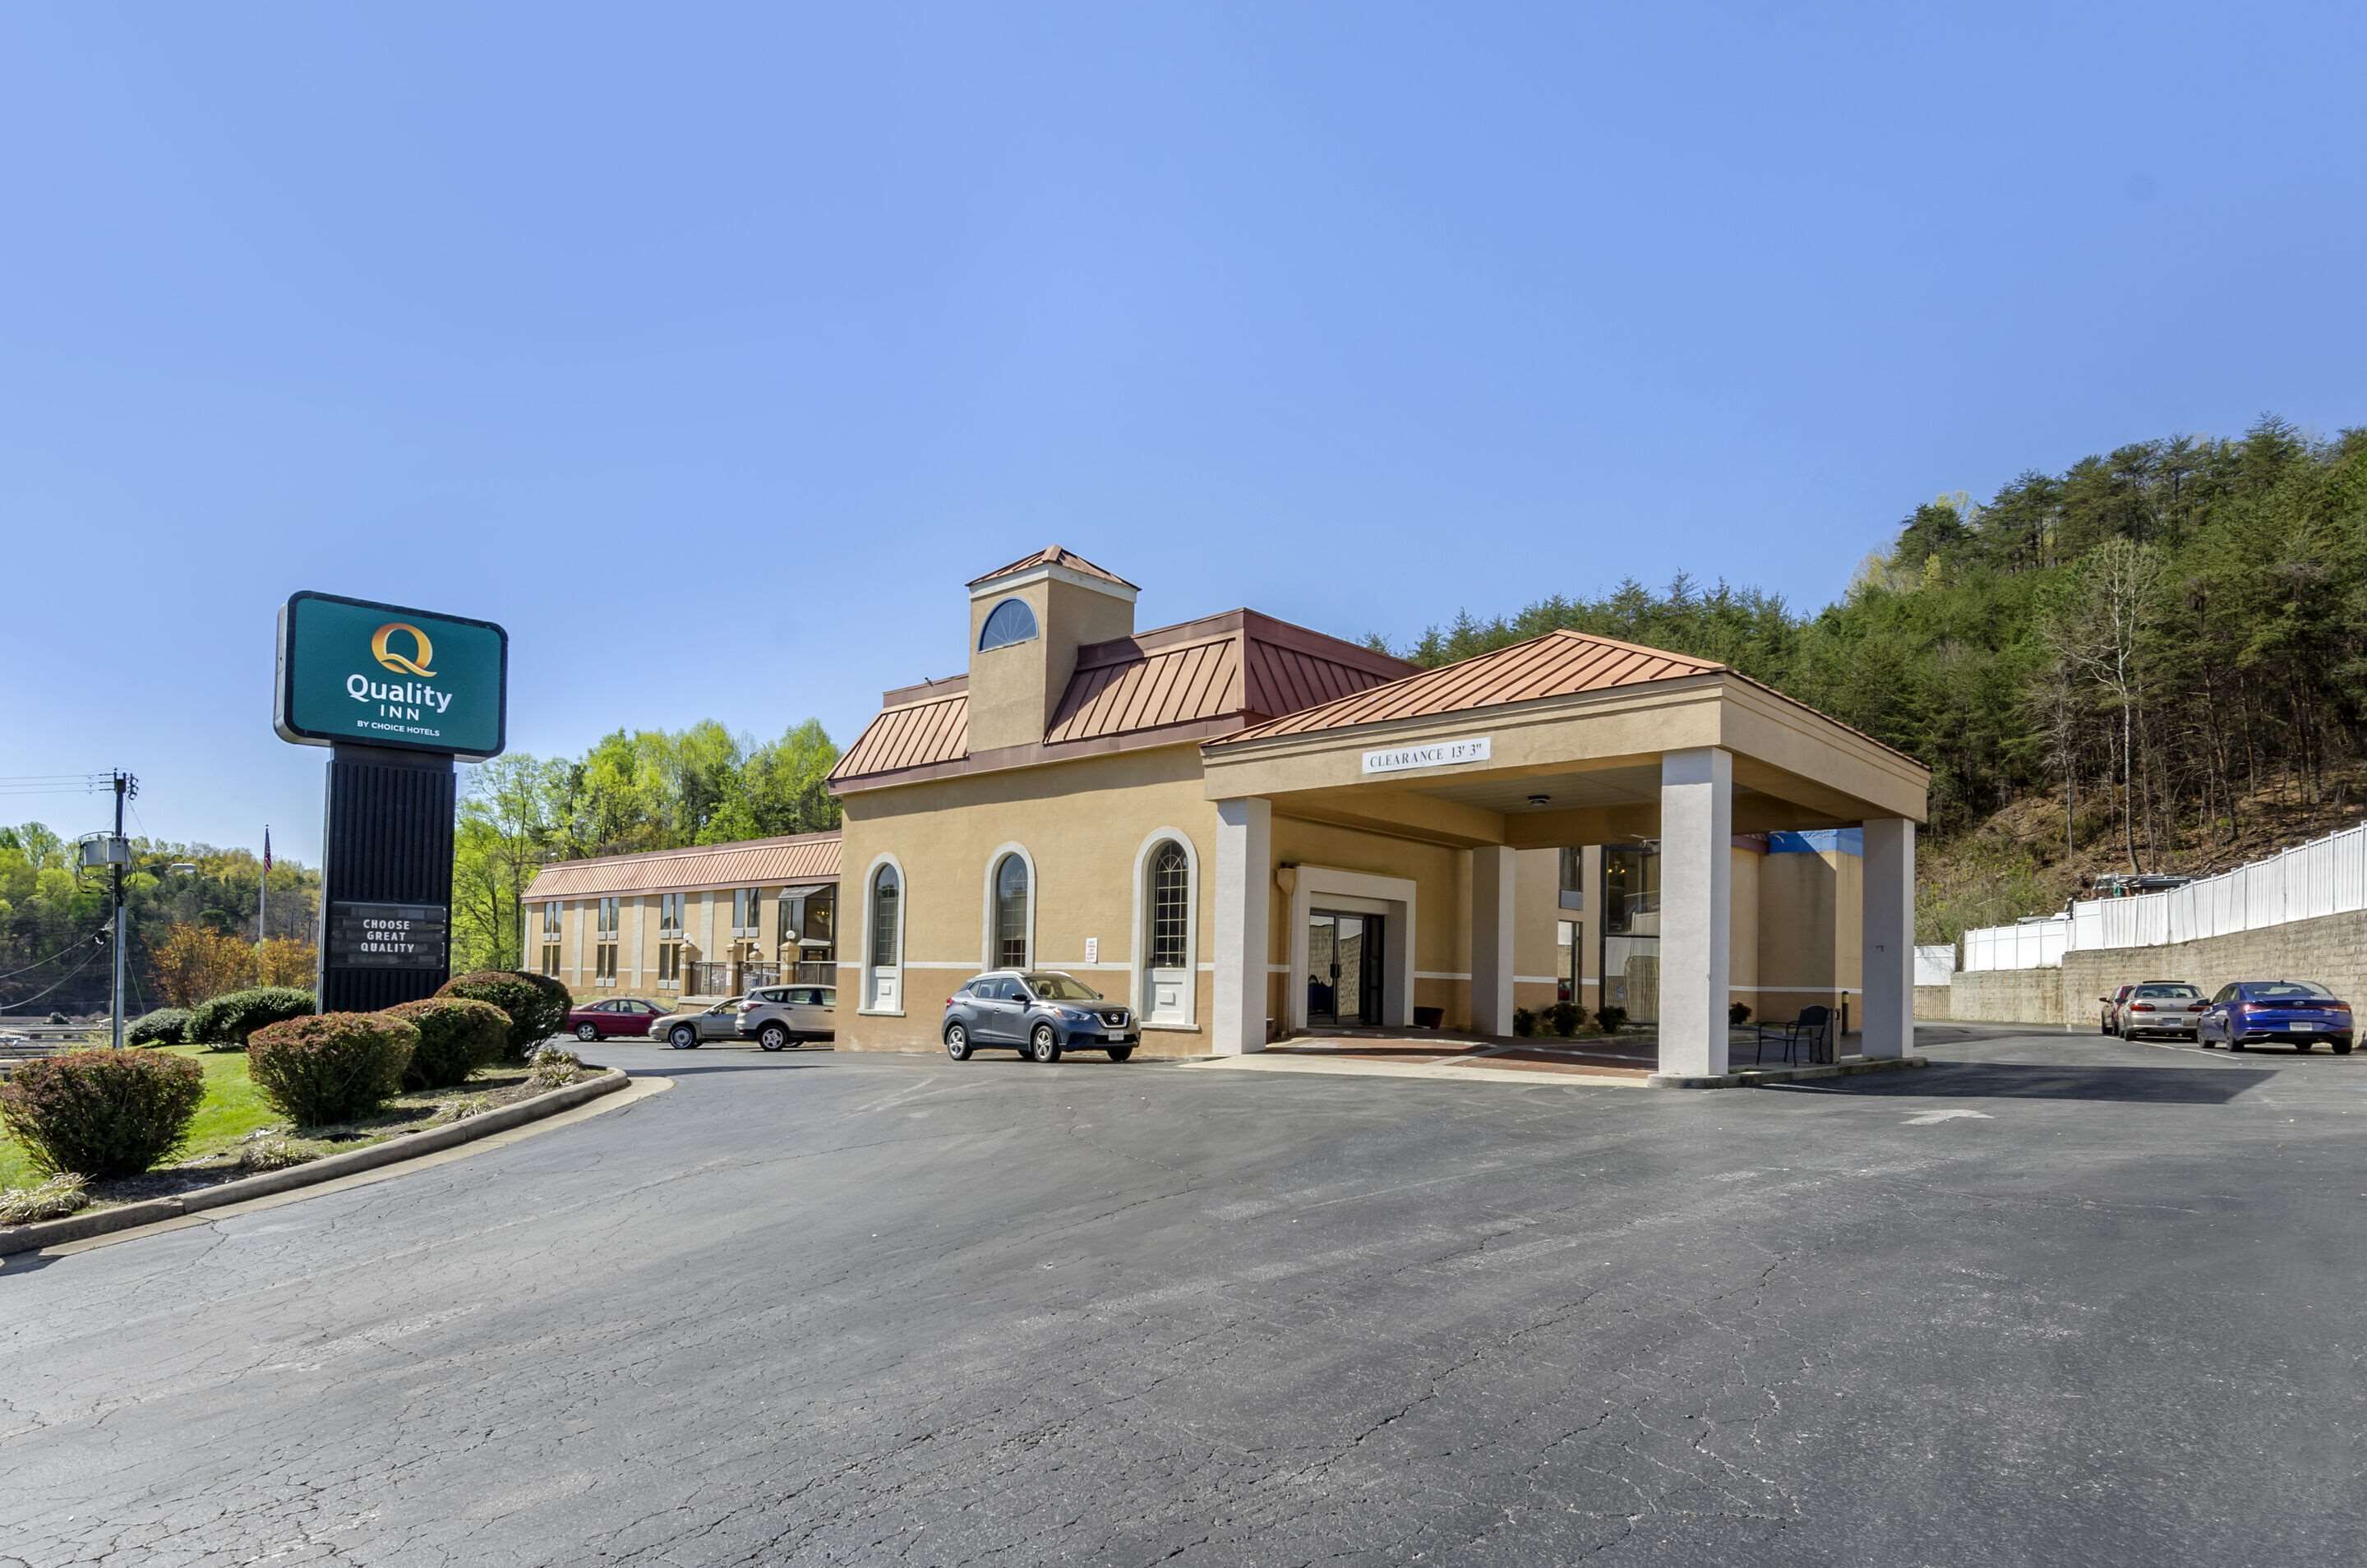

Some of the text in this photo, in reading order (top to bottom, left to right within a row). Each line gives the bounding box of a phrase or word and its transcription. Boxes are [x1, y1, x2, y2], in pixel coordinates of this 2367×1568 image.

[371, 623, 437, 677] Q
[347, 674, 452, 713] Quality
[381, 704, 420, 721] INN
[357, 720, 441, 736] BY CHOICE HOTELS
[1370, 748, 1444, 768] CLEARANCE
[363, 919, 410, 929] CHOOSE
[367, 931, 406, 941] GREAT
[361, 942, 415, 953] QUALITY
